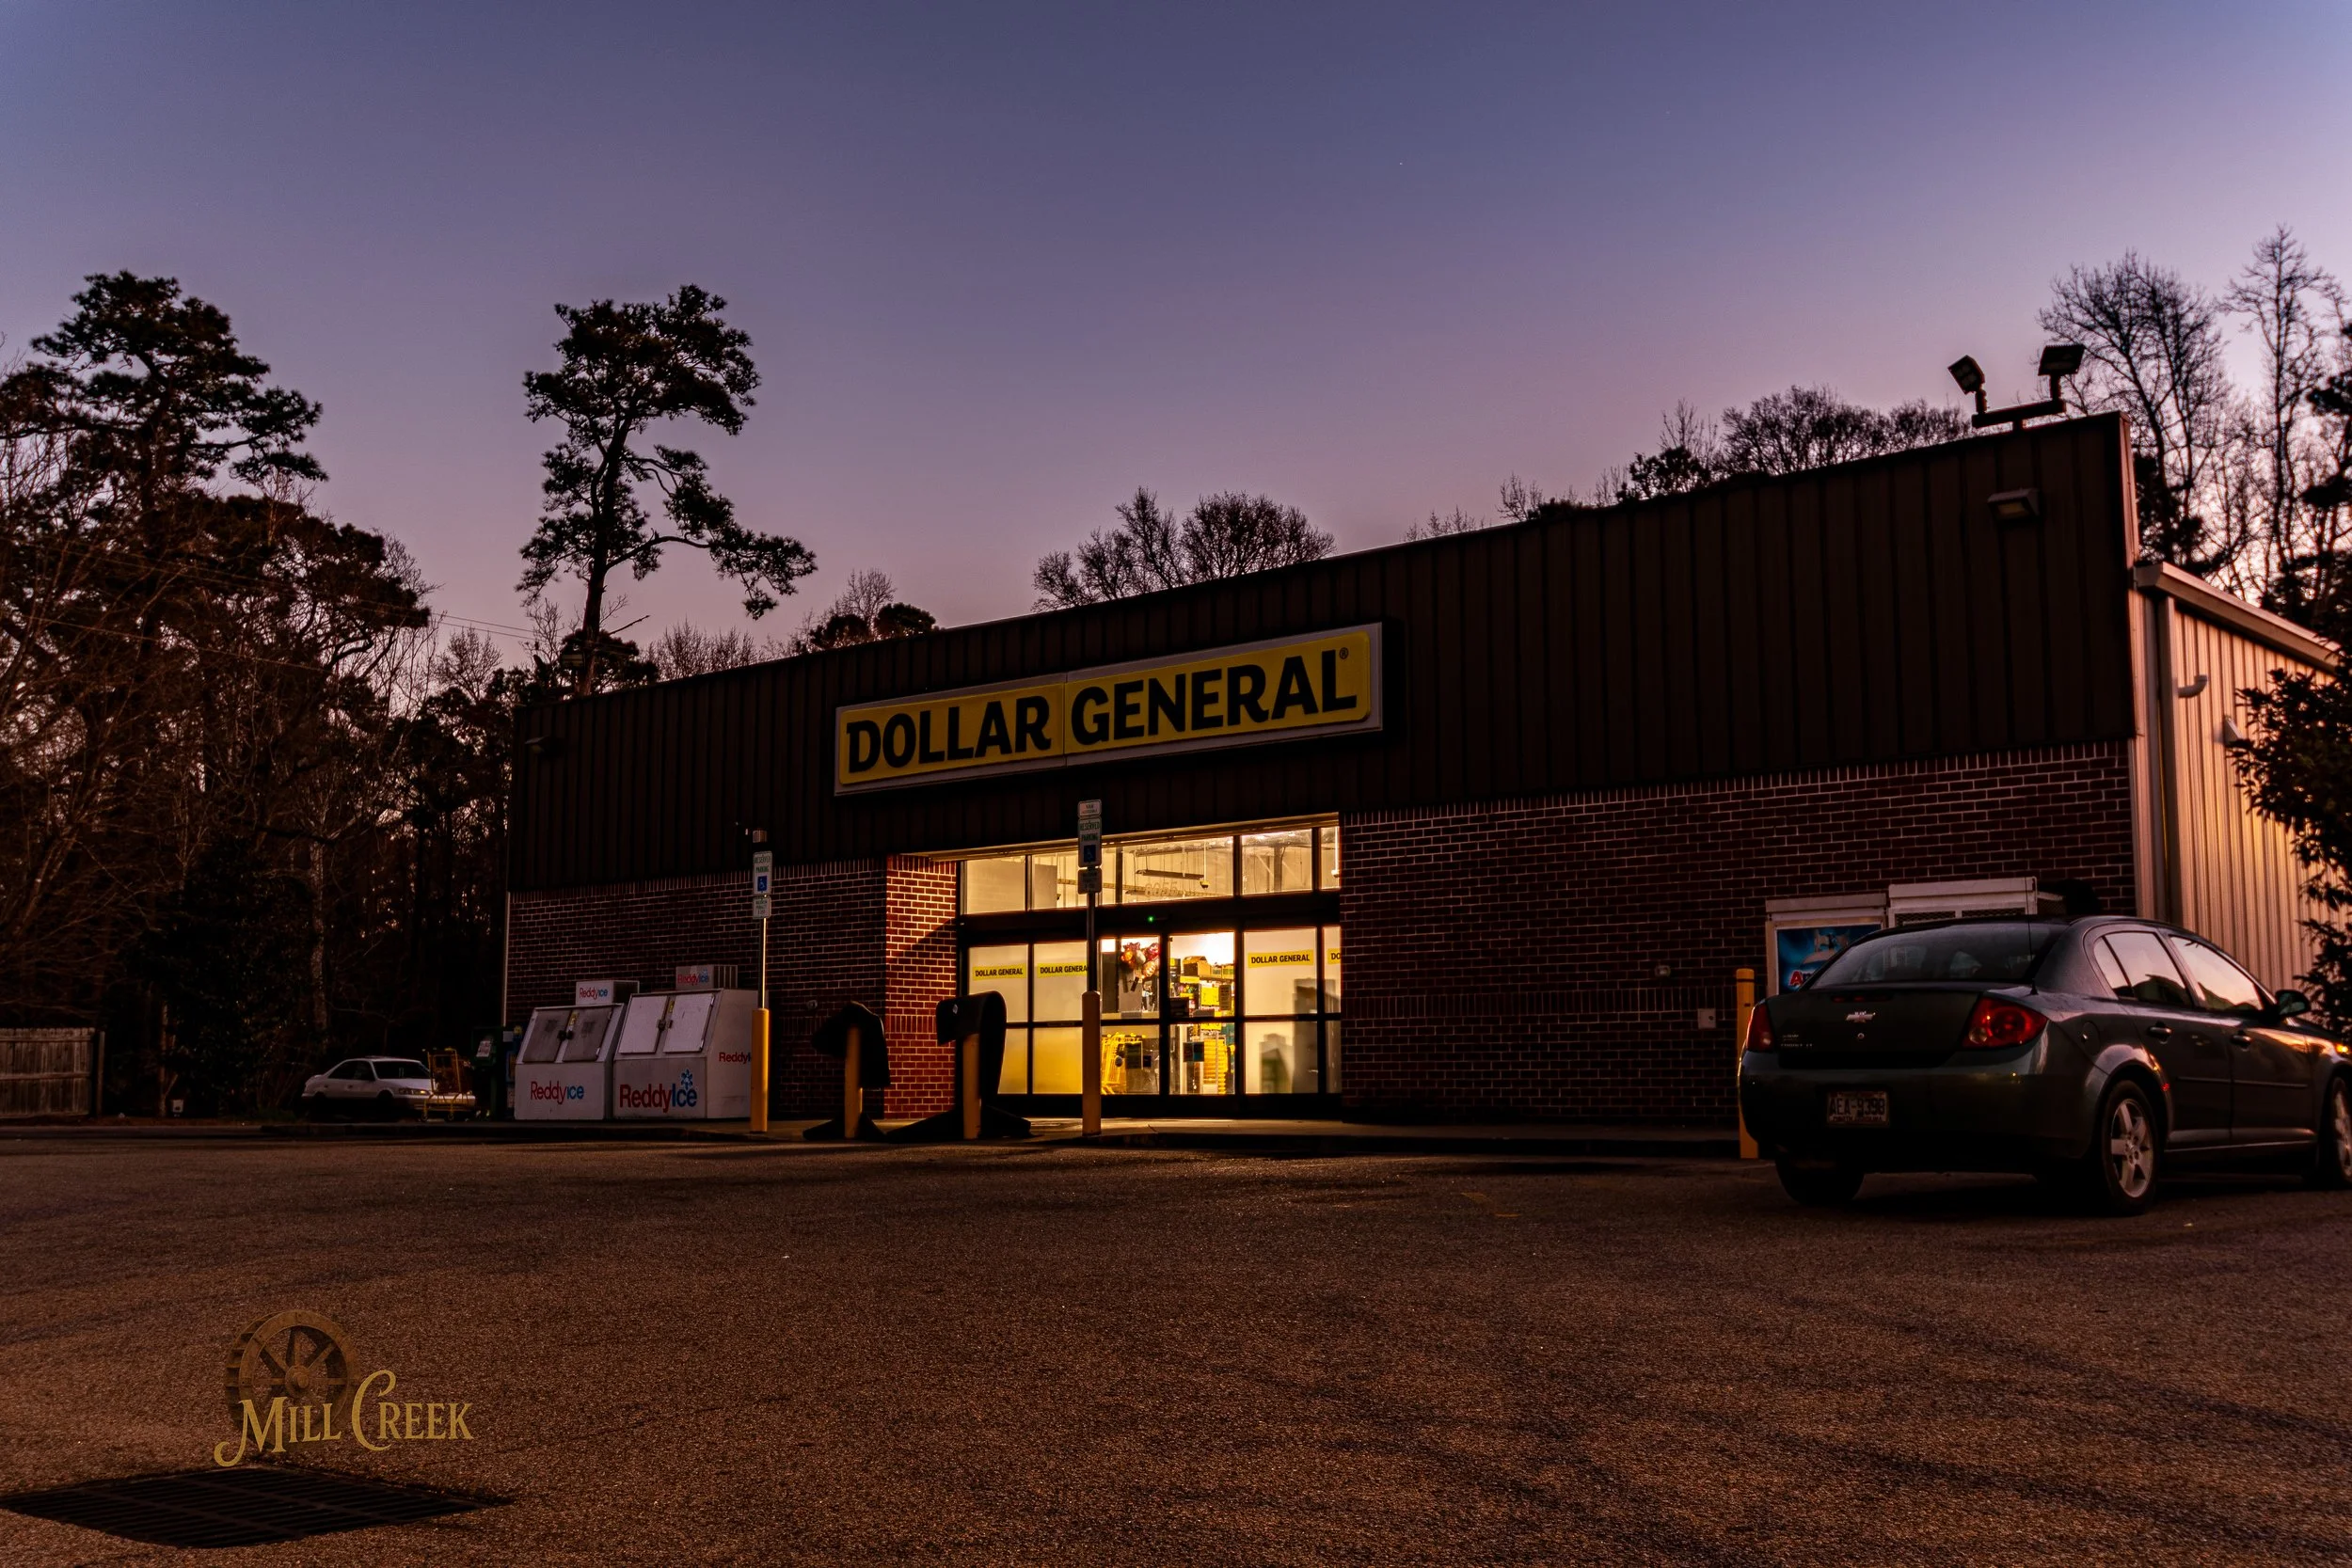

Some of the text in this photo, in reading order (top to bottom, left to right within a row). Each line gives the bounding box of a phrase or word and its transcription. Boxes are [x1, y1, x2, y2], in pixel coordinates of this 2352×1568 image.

[847, 648, 1358, 773] DOLLAR GENERAL
[1251, 954, 1310, 964] DOLLAR GENERAL
[1040, 964, 1089, 974] DOLLAR GENERA
